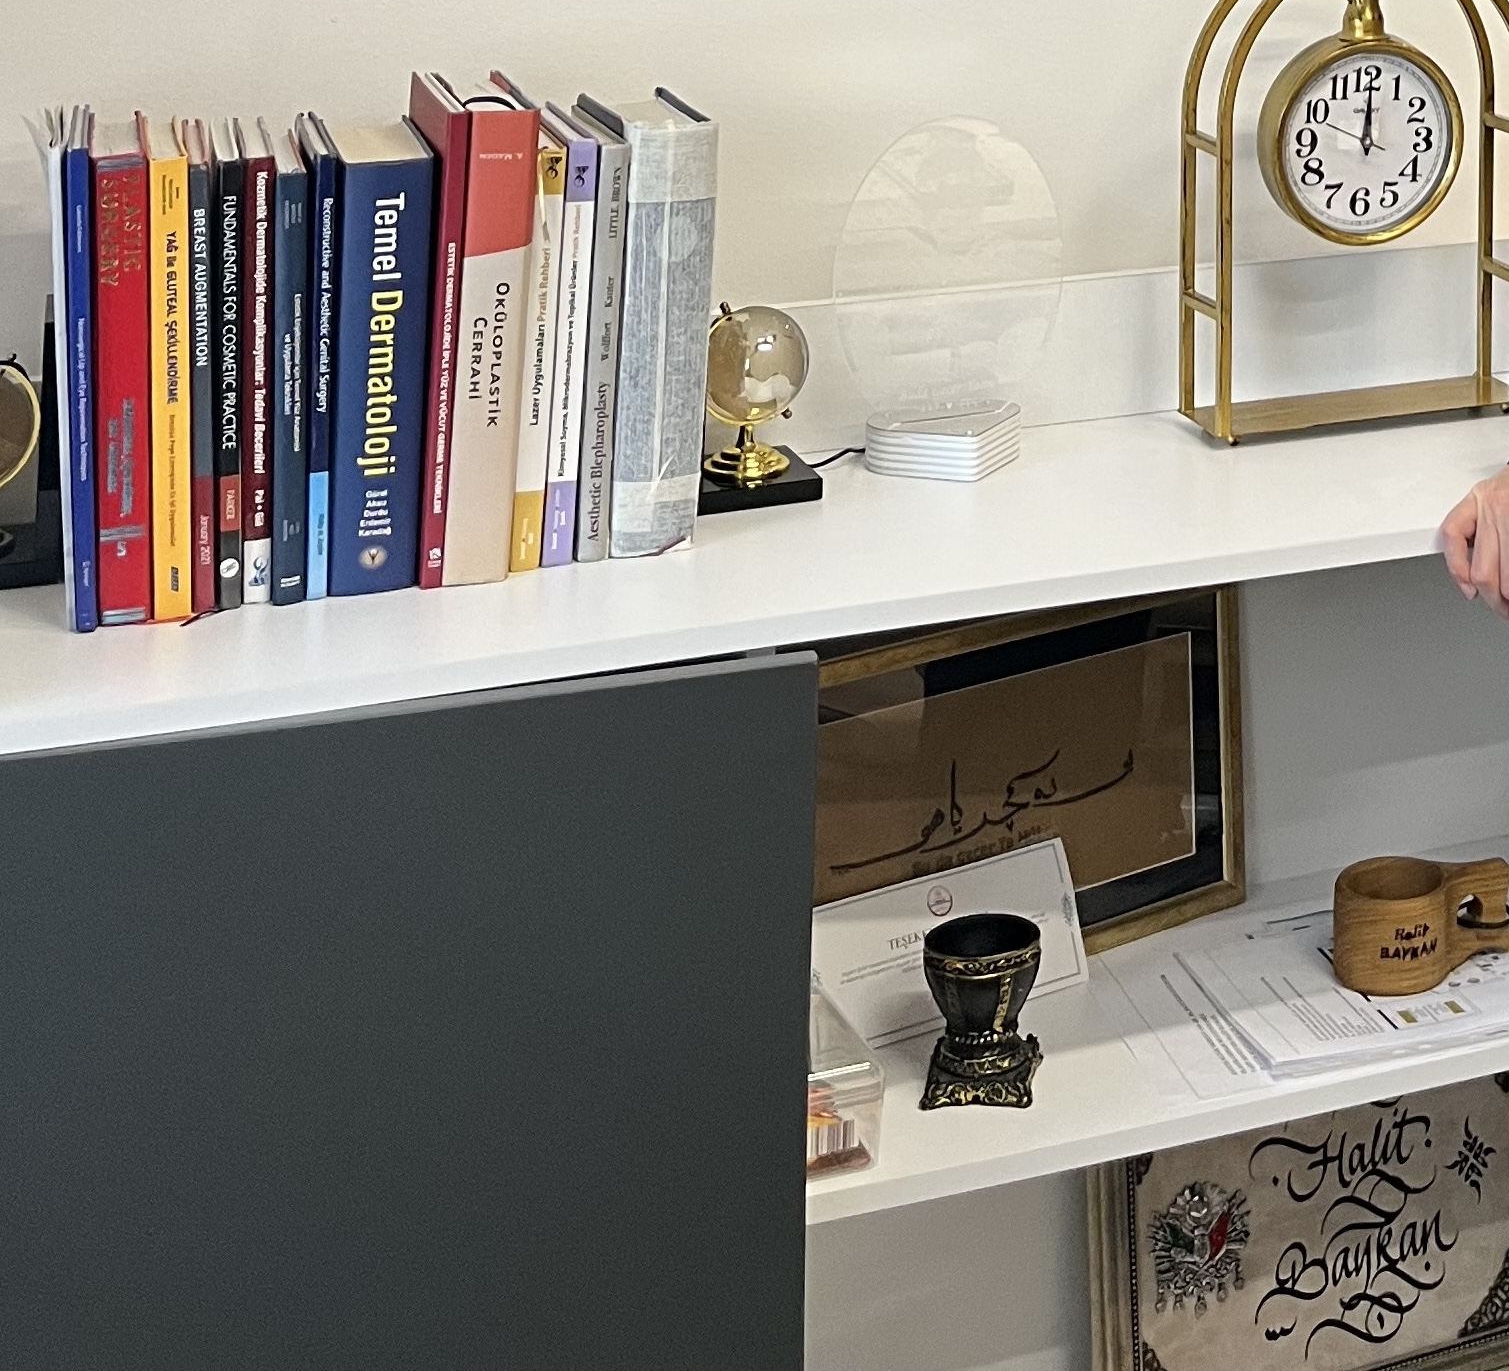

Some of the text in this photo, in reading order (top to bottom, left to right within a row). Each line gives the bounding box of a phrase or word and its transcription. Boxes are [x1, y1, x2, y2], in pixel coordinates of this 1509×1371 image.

[1329, 74, 1349, 101] 11
[1353, 64, 1382, 94] 12
[1392, 74, 1401, 101] 1
[1304, 98, 1330, 125] 10
[1406, 96, 1427, 124] 2
[1295, 127, 1318, 158] 9
[1412, 125, 1433, 153] 3
[1300, 157, 1325, 186] 8
[1398, 154, 1423, 183] 4
[1324, 181, 1344, 210] 7
[1349, 186, 1370, 217] 6
[1379, 180, 1399, 209] 5
[99, 179, 119, 287] SURGERY
[122, 174, 143, 273] PLASTIC
[166, 230, 179, 253] YAĞ
[444, 241, 457, 277] ESTETİK
[166, 270, 178, 318] GLUTEAL
[193, 208, 208, 367] BREAST AUGMENTATION
[604, 276, 615, 308] Kanter
[315, 197, 334, 413] Reconstructive and Aesthetic Genital Surgery
[441, 277, 455, 350] DERMATOLOJİDE
[221, 195, 238, 450] FUNDAMENTALS FOR COSMETIC PRACTICE
[252, 171, 268, 474] Kozmetik Dermatolojide Komplikasyonlar: Tedavi Becerileri
[356, 191, 406, 477] Temel Dermatoloji
[531, 248, 551, 426] Lazer Uygulamaları Pratik Rehberi
[164, 320, 180, 404] ŞEKİLLENDİRME
[468, 316, 488, 400] CERRAHİ
[486, 282, 511, 428] OKÜLOPLASTİK
[439, 370, 451, 388] YÜZ
[439, 390, 448, 401] VE
[436, 402, 449, 432] VÜCUT
[586, 382, 610, 542] Aesthetic Blepharoplasty
[225, 489, 236, 520] PARKER
[432, 464, 445, 514] TEKNİKLERİ
[198, 514, 211, 565] January 2021
[1380, 937, 1438, 962] BAYKAN
[1253, 1108, 1432, 1203] Halit
[1262, 1209, 1458, 1303] Baykan
